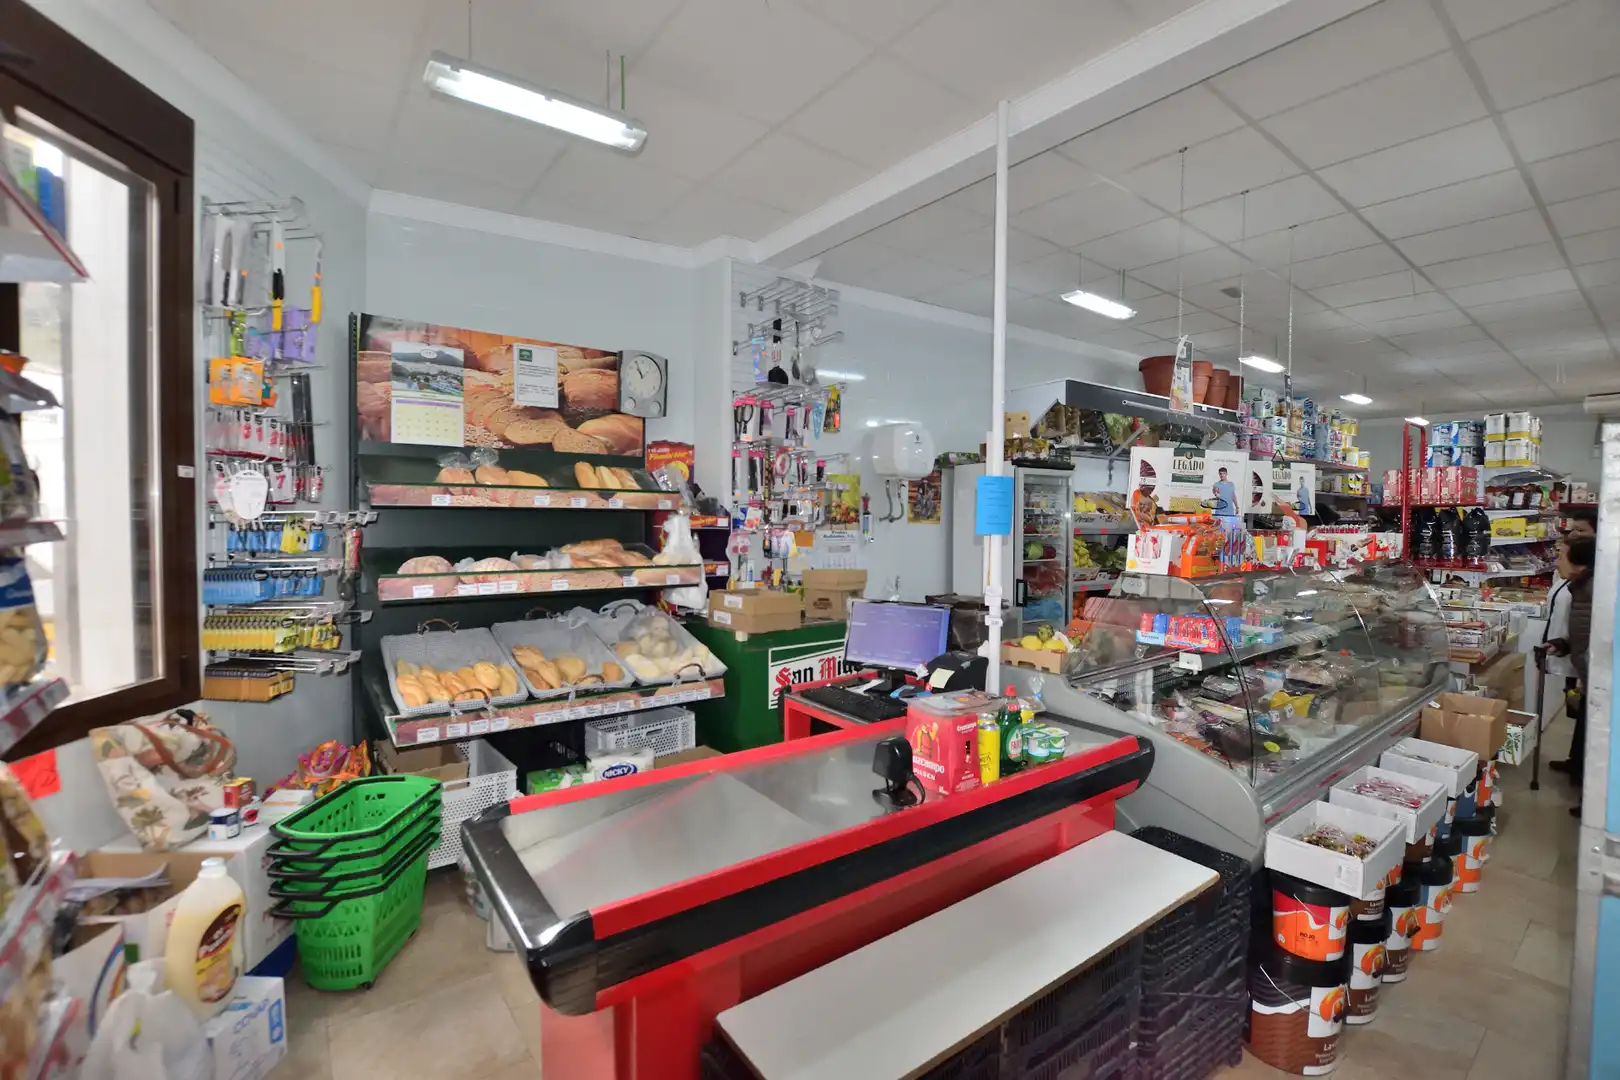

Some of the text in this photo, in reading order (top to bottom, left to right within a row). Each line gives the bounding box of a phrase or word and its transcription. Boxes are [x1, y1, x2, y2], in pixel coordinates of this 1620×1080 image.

[1173, 459, 1205, 471] LEGADO
[276, 474, 286, 489] 7
[773, 666, 814, 696] San
[912, 755, 945, 774] uzcampo
[604, 767, 629, 778] NICKY
